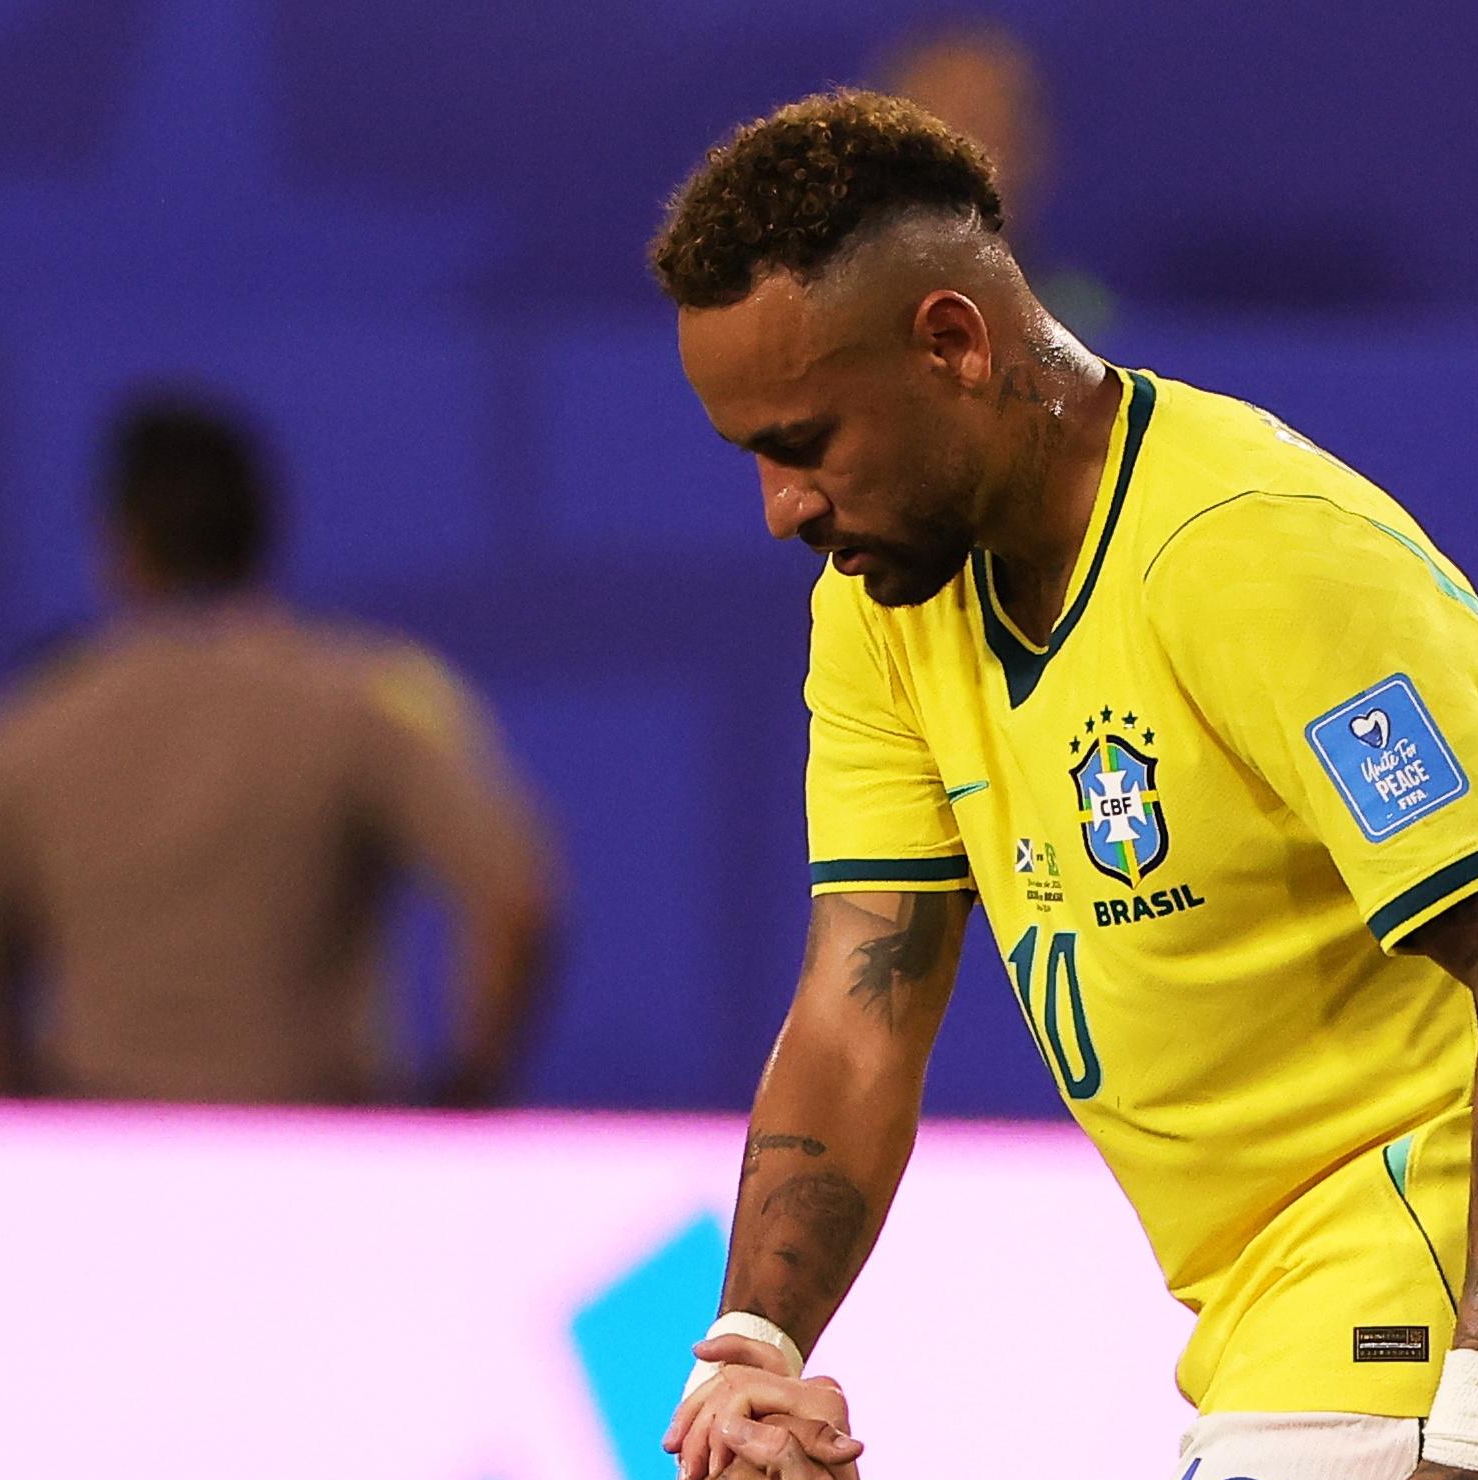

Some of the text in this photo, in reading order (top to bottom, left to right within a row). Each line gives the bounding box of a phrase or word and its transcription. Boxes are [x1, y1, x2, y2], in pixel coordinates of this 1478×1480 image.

[1361, 750, 1399, 783] Unite
[1375, 760, 1429, 803] PEACE
[1101, 797, 1132, 816] CBF
[1397, 789, 1427, 811] FIFA
[1094, 884, 1205, 927] BRASIL
[1008, 925, 1101, 1100] 10
